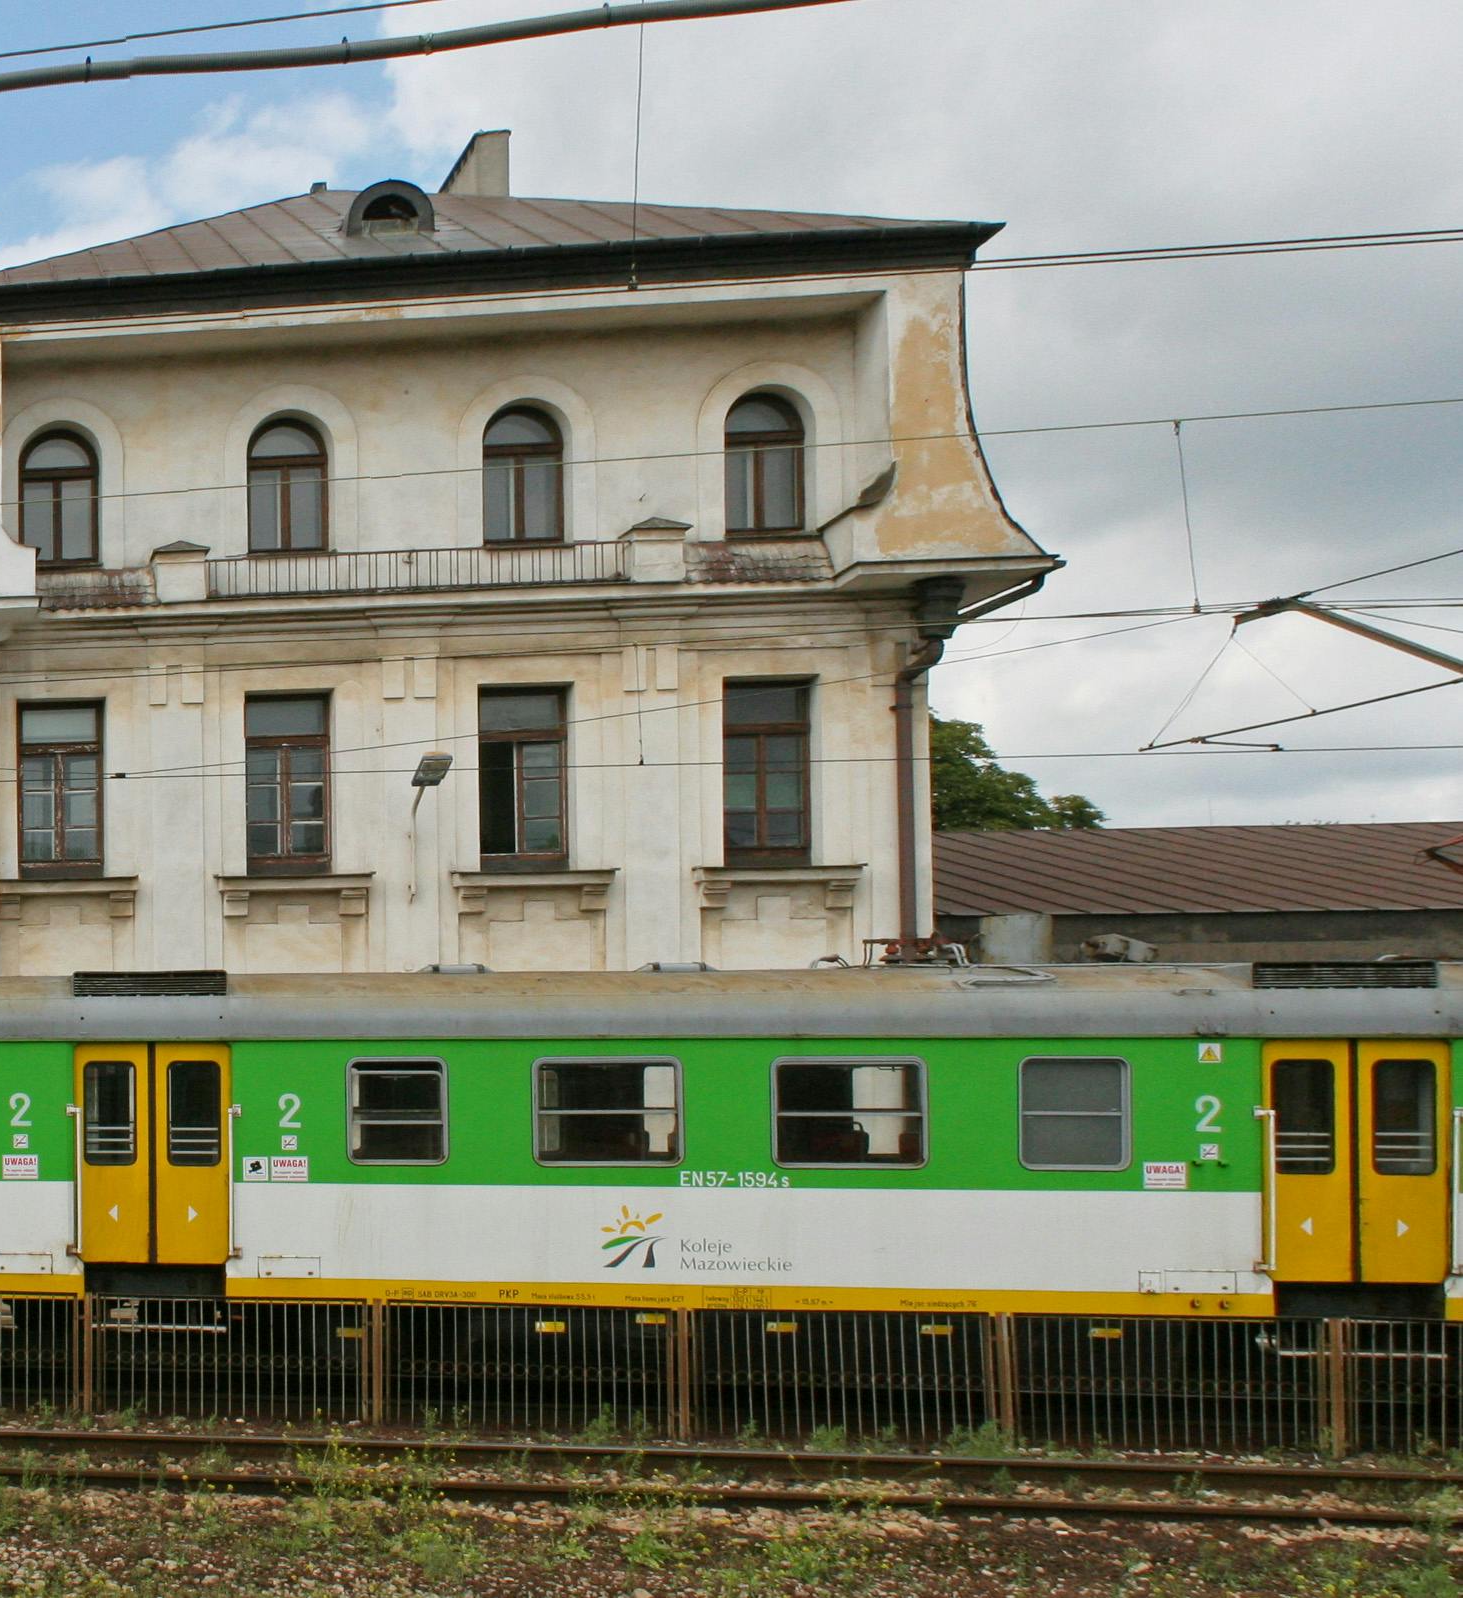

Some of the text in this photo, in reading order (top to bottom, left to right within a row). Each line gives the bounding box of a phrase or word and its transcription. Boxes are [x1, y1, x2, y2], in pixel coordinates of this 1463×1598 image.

[9, 1092, 32, 1126] 2
[278, 1093, 302, 1128] 2
[1195, 1095, 1221, 1132] 2
[4, 1157, 37, 1166] UWAGA!
[273, 1159, 307, 1168] UWAGA!
[1145, 1165, 1184, 1174] UWAGA!
[680, 1237, 732, 1257] Koleje
[680, 1256, 793, 1272] Mazowieckie
[499, 1289, 520, 1299] PKP
